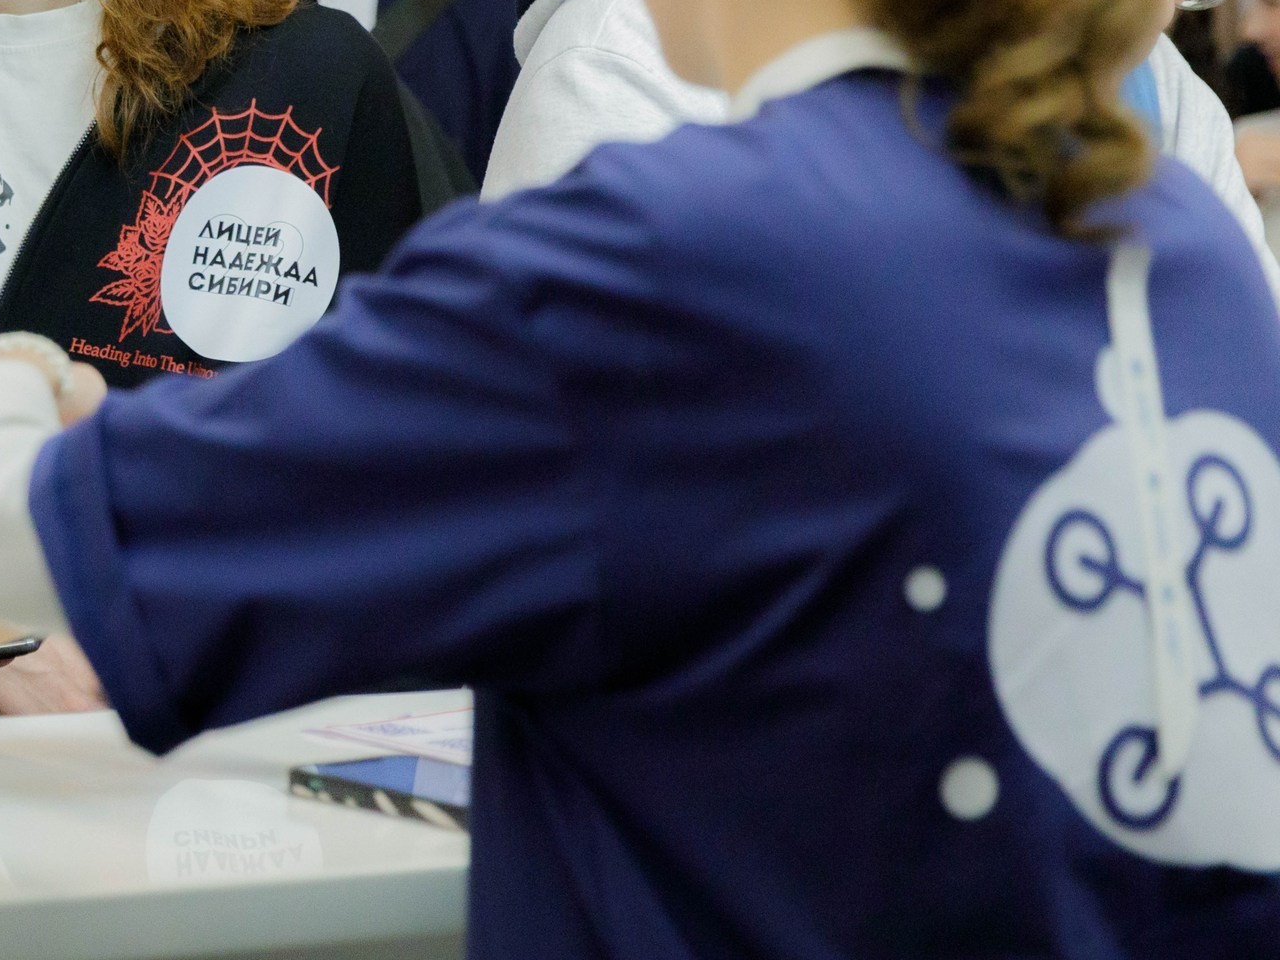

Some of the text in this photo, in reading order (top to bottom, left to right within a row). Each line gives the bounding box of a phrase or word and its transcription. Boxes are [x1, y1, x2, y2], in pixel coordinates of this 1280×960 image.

[198, 219, 282, 247] ЛИЦЕЙ
[192, 245, 319, 288] НАДЕЖДА
[188, 271, 292, 305] СИБИРИ
[70, 337, 131, 368] Heading
[132, 350, 158, 368] Into
[160, 354, 186, 374] The
